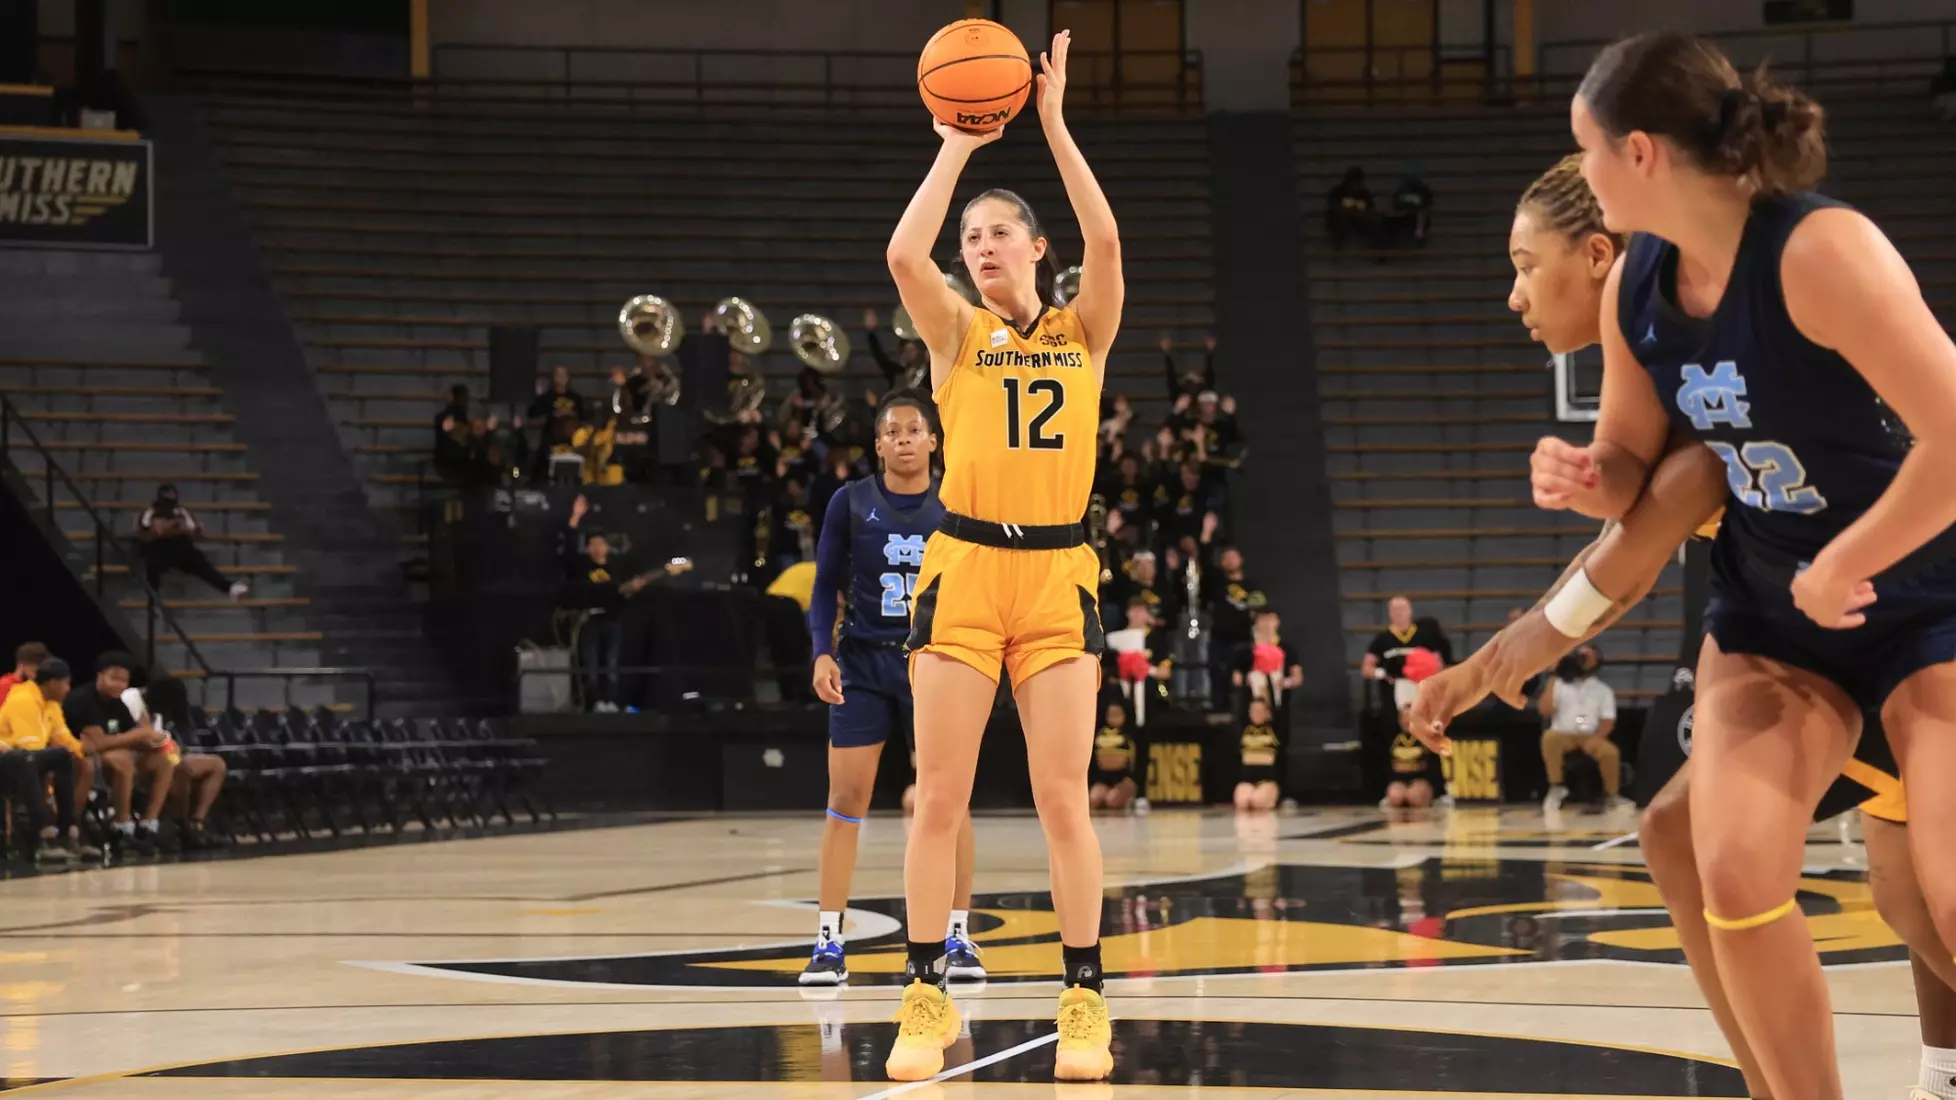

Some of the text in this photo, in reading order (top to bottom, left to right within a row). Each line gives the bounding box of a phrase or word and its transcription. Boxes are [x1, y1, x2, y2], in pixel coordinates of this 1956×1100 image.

[957, 107, 1011, 125] NCAA
[0, 157, 138, 196] UTHERN
[0, 193, 72, 224] MISS
[975, 349, 1083, 368] SOUTHERN MISS
[1002, 377, 1065, 451] 12
